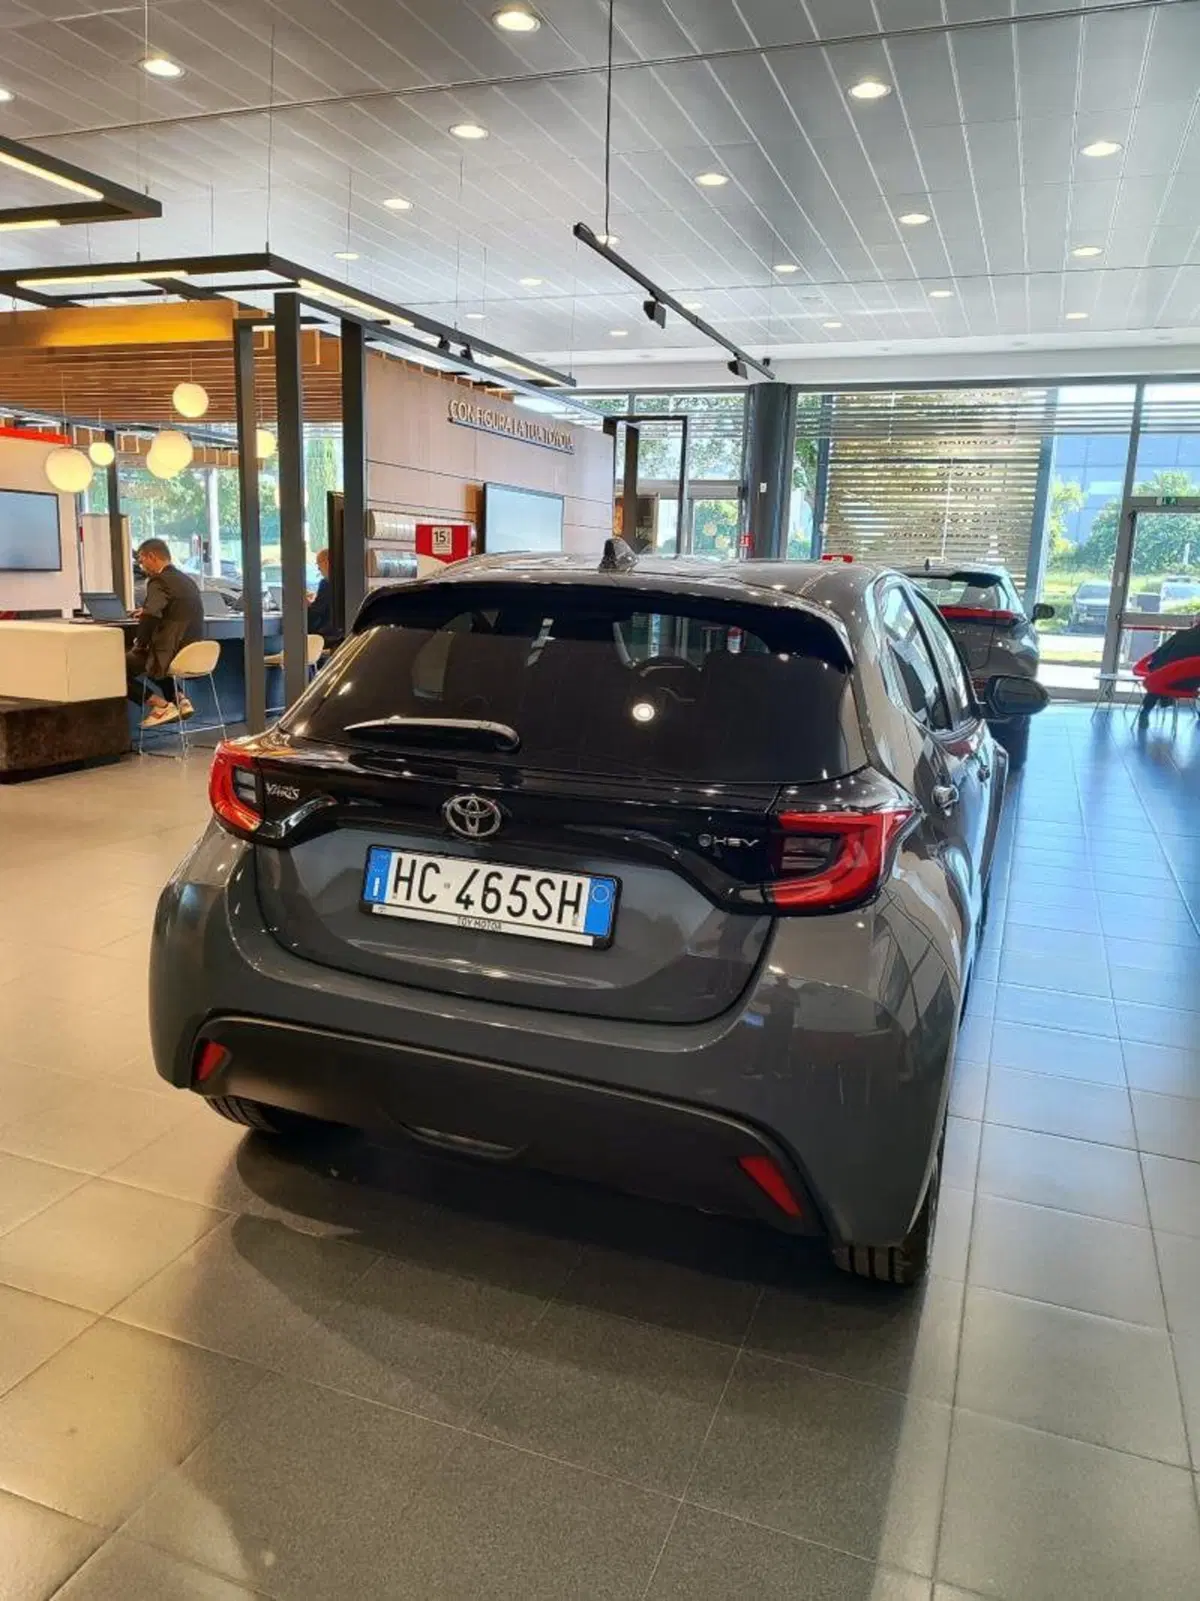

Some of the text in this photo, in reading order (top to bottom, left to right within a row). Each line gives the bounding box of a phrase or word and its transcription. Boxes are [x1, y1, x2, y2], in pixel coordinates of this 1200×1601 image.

[449, 399, 512, 435] CONFIGURA
[542, 427, 574, 450] TOYOTA
[433, 530, 447, 543] 15
[392, 856, 583, 925] HC 465SH
